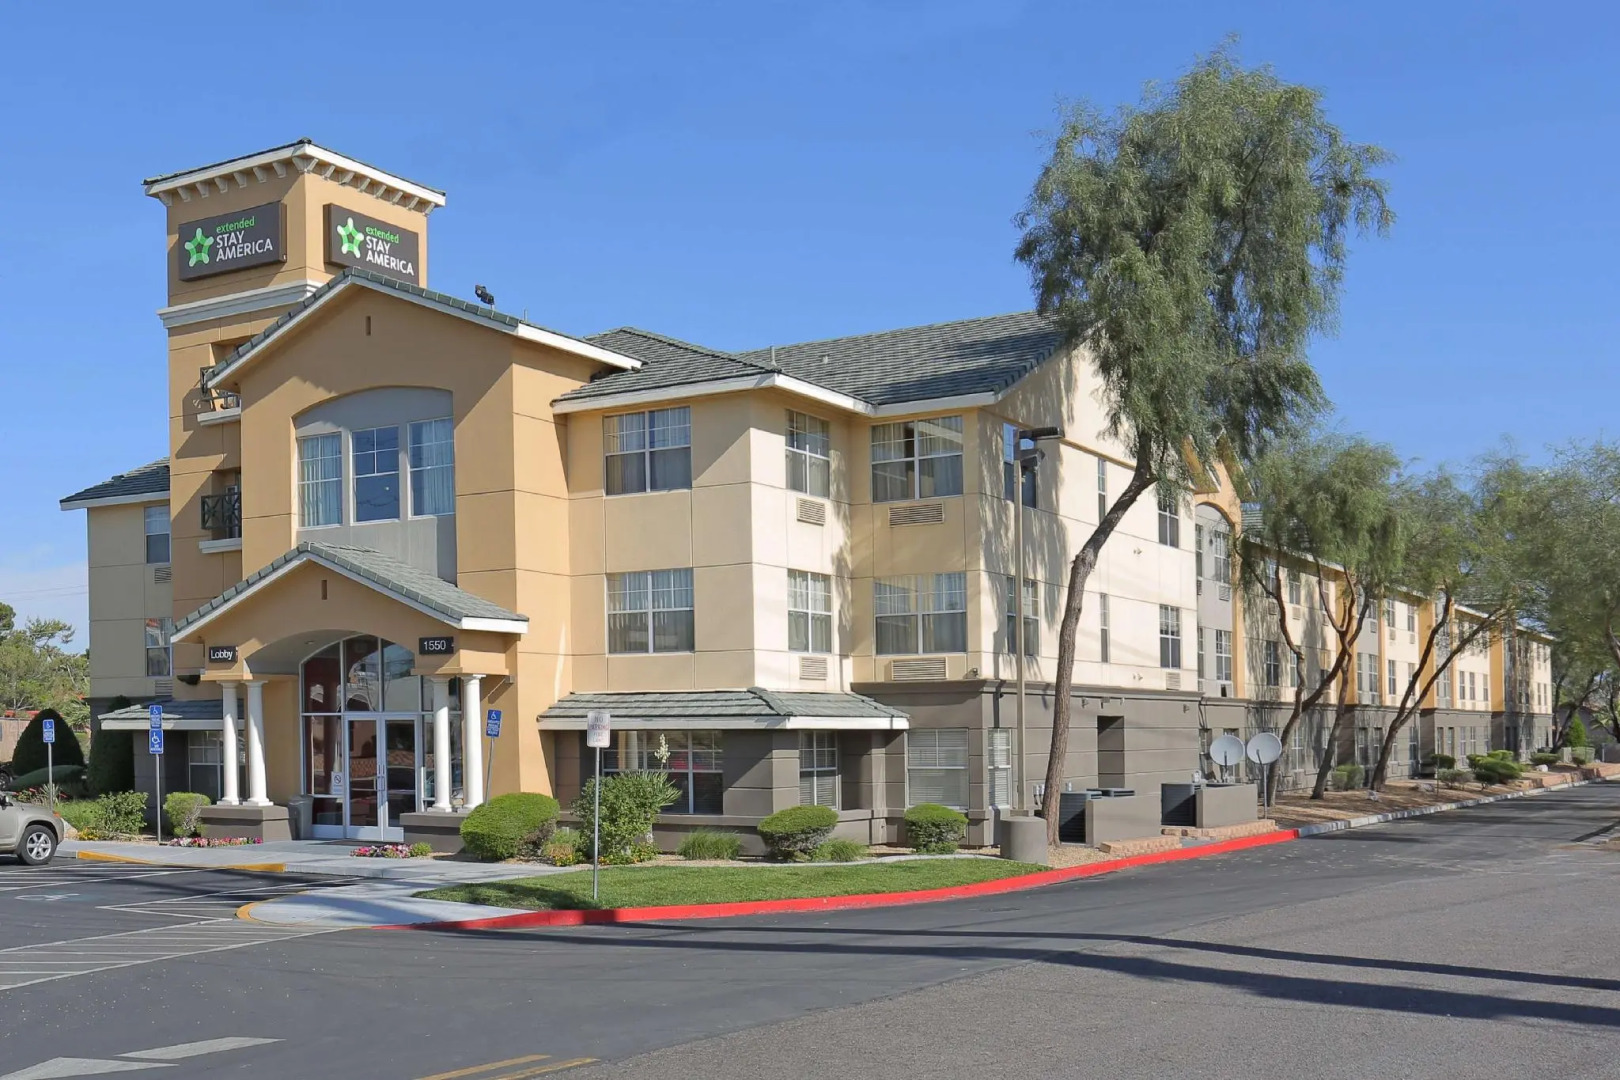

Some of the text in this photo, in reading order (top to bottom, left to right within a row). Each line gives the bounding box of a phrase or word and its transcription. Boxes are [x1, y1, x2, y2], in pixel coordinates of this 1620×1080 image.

[216, 216, 255, 233] extended
[216, 231, 244, 248] STAY
[366, 226, 399, 243] extended
[216, 239, 273, 262] AMERICA
[366, 236, 391, 254] STAY
[366, 250, 414, 276] AMERICA
[424, 640, 446, 650] 1550
[211, 649, 233, 660] Lobby
